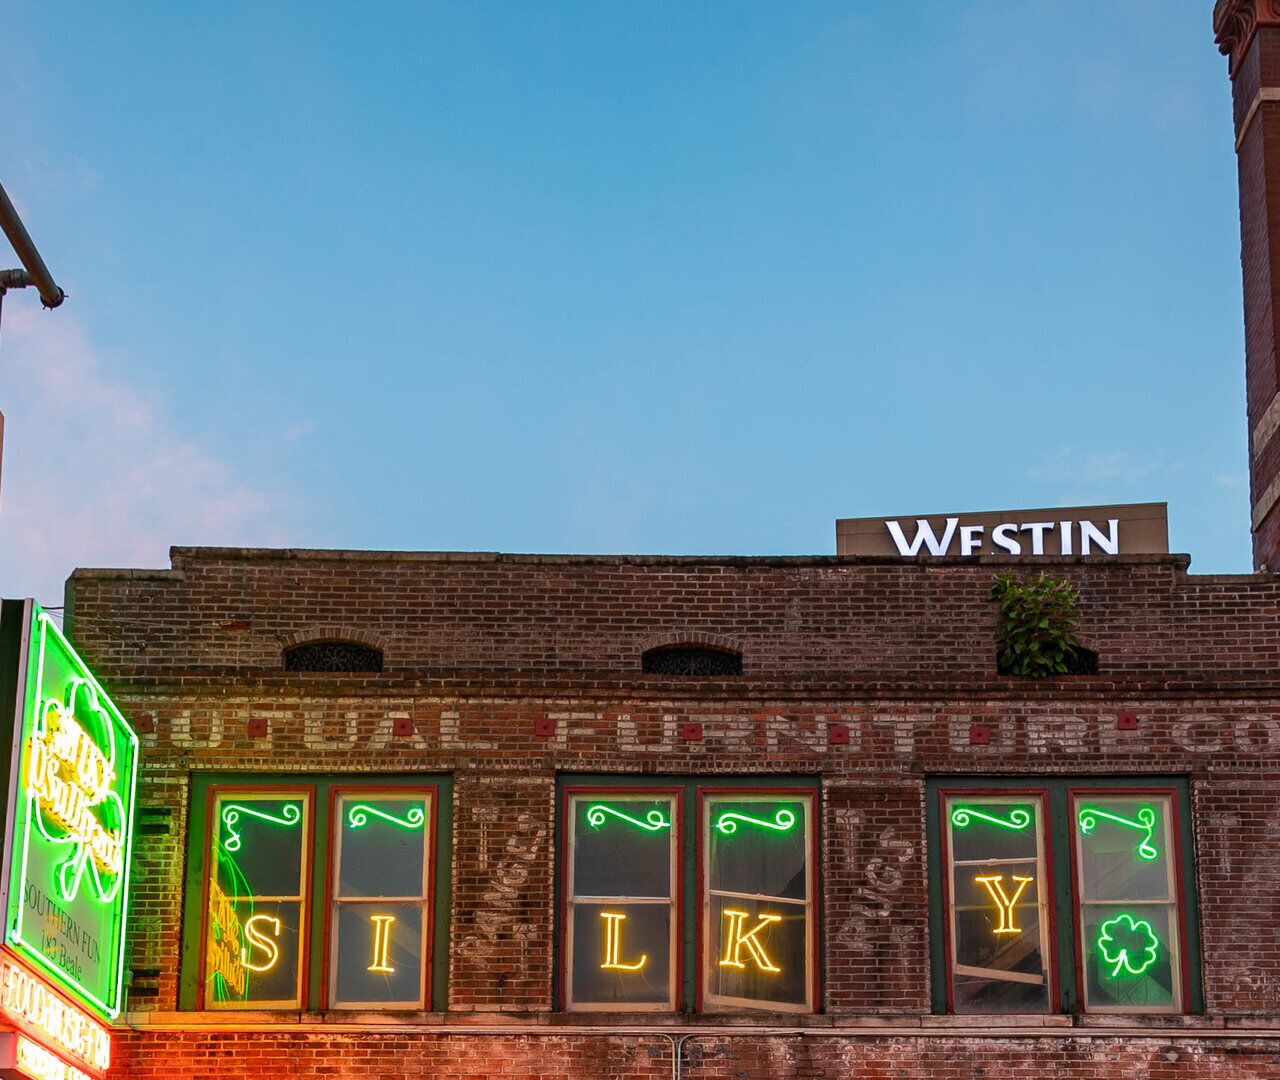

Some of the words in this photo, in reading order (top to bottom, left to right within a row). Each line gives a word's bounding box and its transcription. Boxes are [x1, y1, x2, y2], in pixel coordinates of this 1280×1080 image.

[884, 517, 1120, 557] WESTIN
[141, 709, 498, 753] UTUAL
[59, 943, 82, 981] Beale
